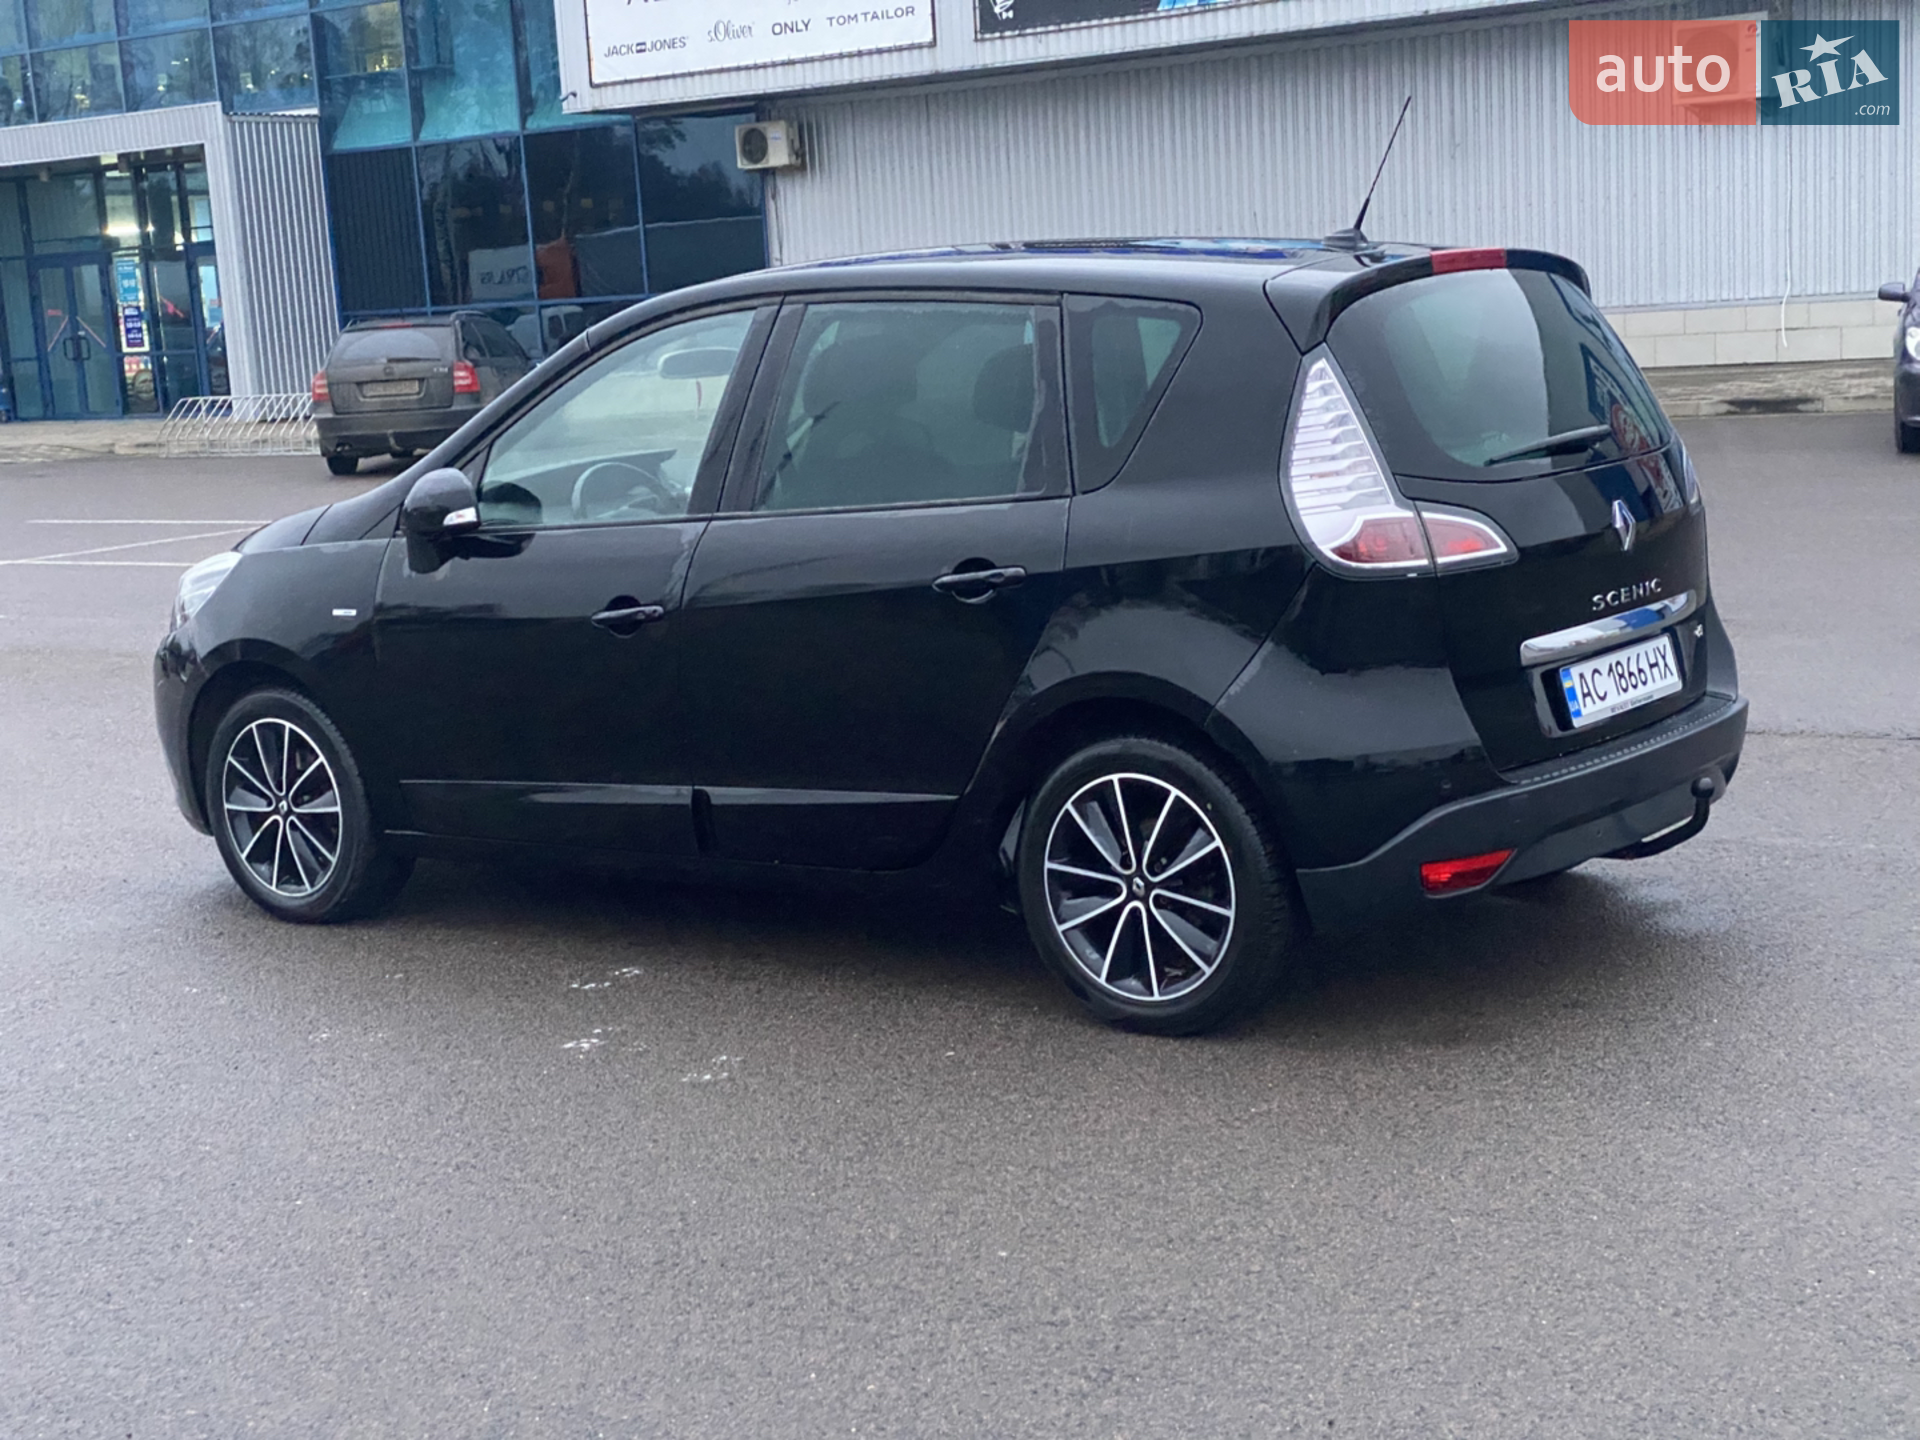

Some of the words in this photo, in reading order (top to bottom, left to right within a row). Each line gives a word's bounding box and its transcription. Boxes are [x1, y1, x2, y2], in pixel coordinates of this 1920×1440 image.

[771, 18, 812, 36] ONLY
[826, 13, 858, 28] TOM
[861, 6, 916, 23] TAILOR
[604, 43, 635, 58] JACK
[648, 36, 688, 53] JONES
[1592, 577, 1662, 611] SCENIC
[1578, 667, 1608, 709] AC
[1607, 652, 1648, 697] 1866
[1644, 643, 1674, 684] HX
